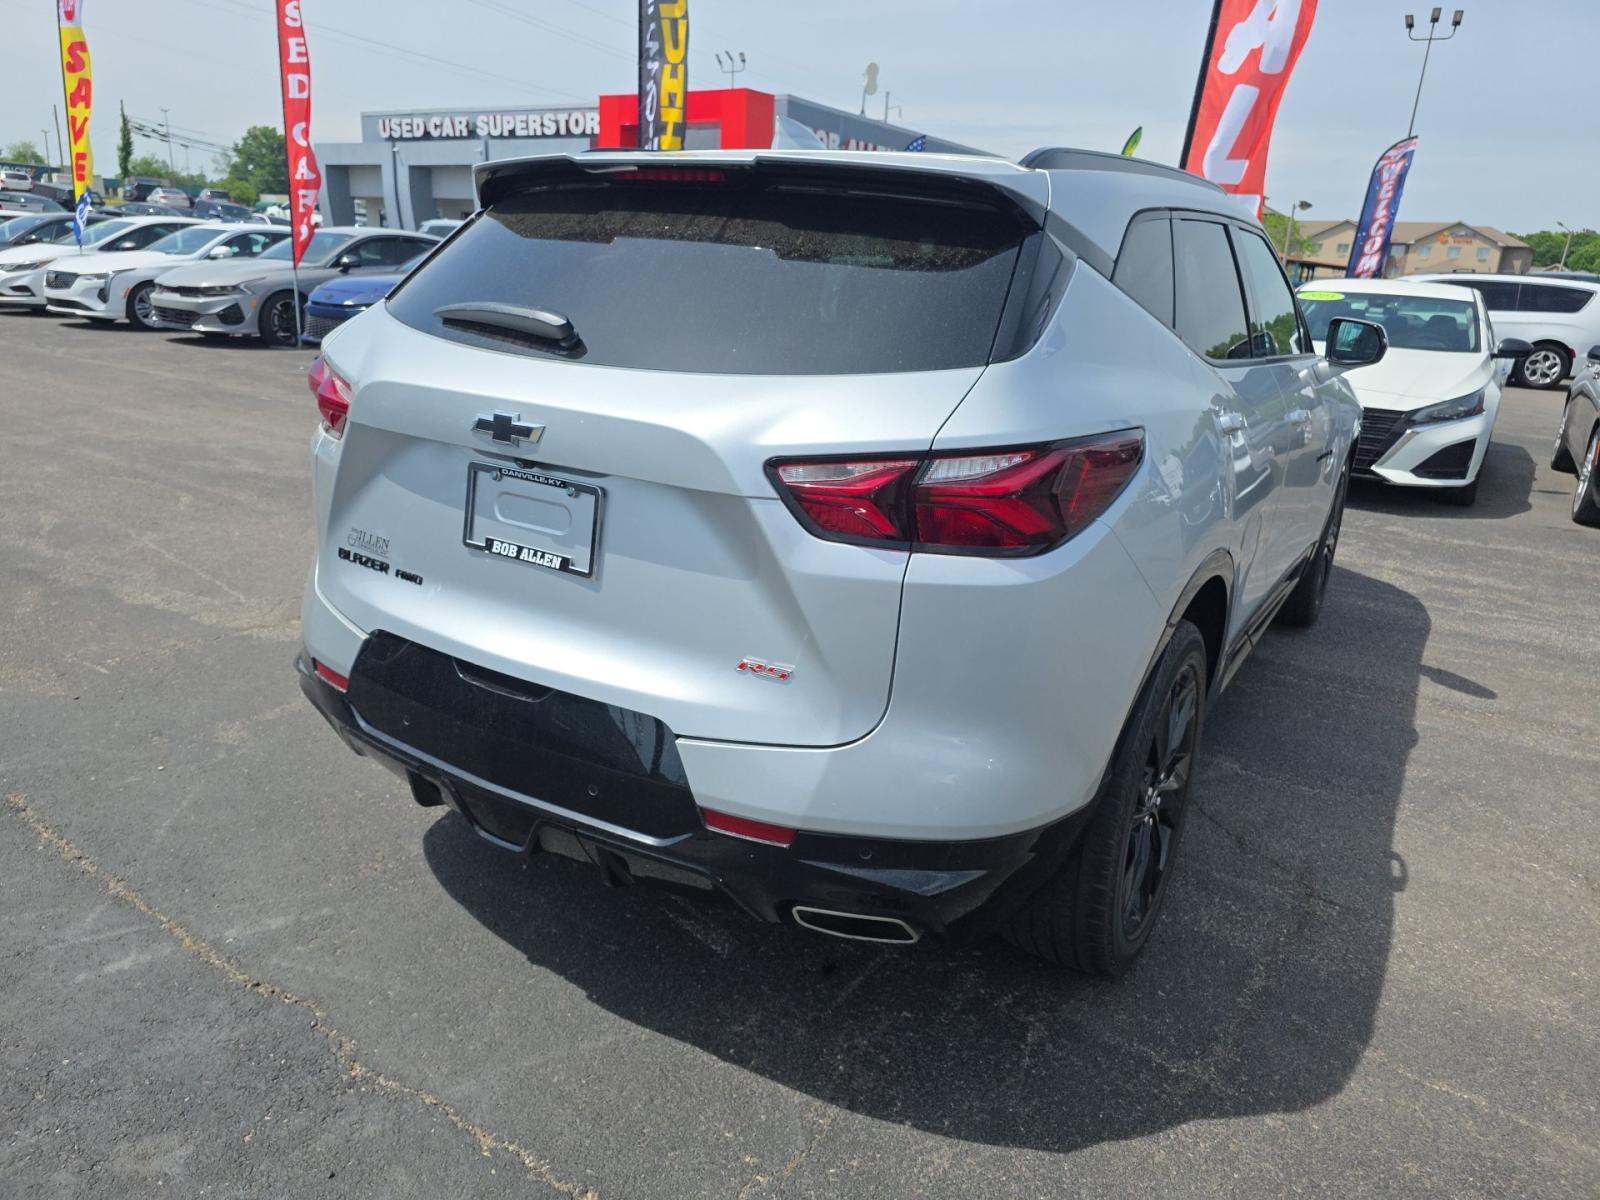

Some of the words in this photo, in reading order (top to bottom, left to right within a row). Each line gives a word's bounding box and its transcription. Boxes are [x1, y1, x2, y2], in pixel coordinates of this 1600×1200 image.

[284, 0, 310, 99] SED
[1202, 0, 1301, 185] AL
[65, 41, 92, 182] SAVE
[379, 117, 426, 138] USED
[427, 115, 470, 138] CAR
[475, 112, 600, 137] SUPERSTOR
[337, 546, 390, 575] BLAZER
[491, 540, 517, 558] BOB
[519, 547, 562, 569] ALLEN
[736, 656, 794, 682] RS
